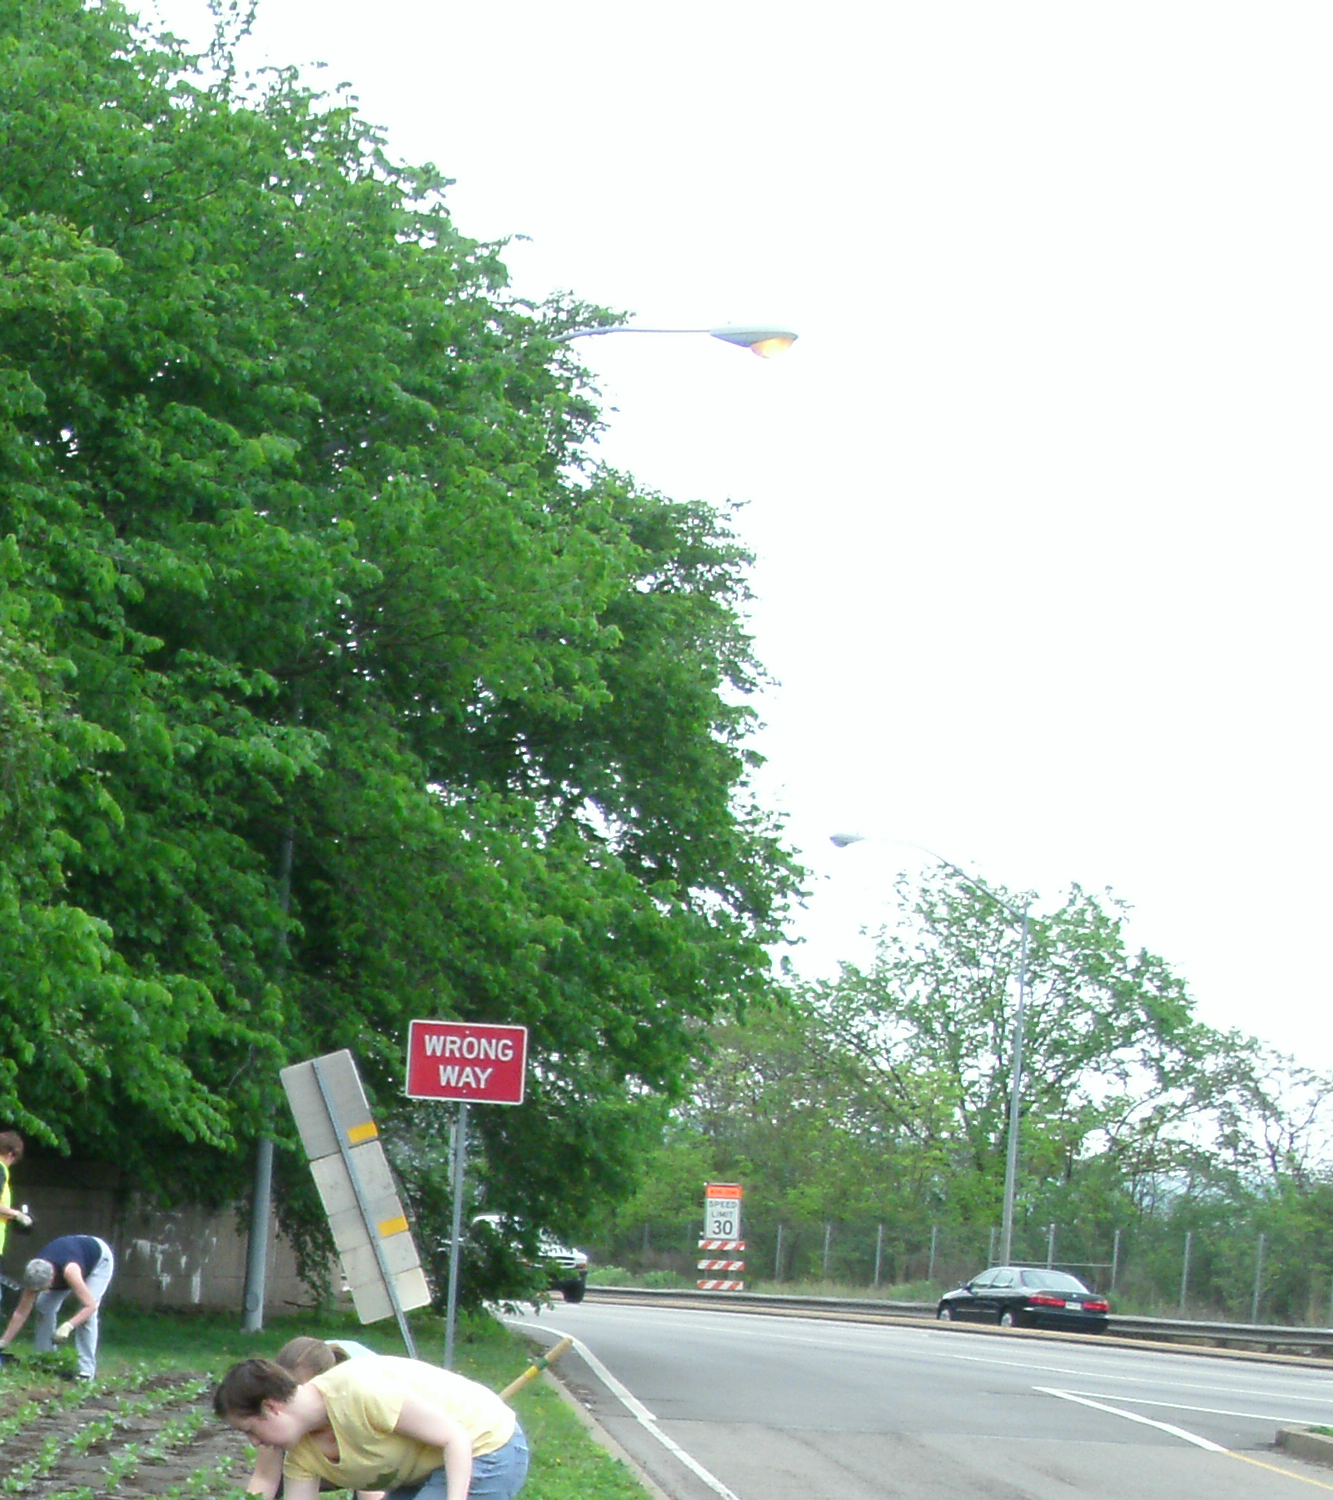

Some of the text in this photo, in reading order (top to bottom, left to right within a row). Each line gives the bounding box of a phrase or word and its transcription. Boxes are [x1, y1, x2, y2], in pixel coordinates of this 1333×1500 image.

[424, 1034, 514, 1062] WRONG
[439, 1064, 493, 1089] WAY
[709, 1201, 737, 1209] SPEED
[712, 1220, 733, 1235] 30
